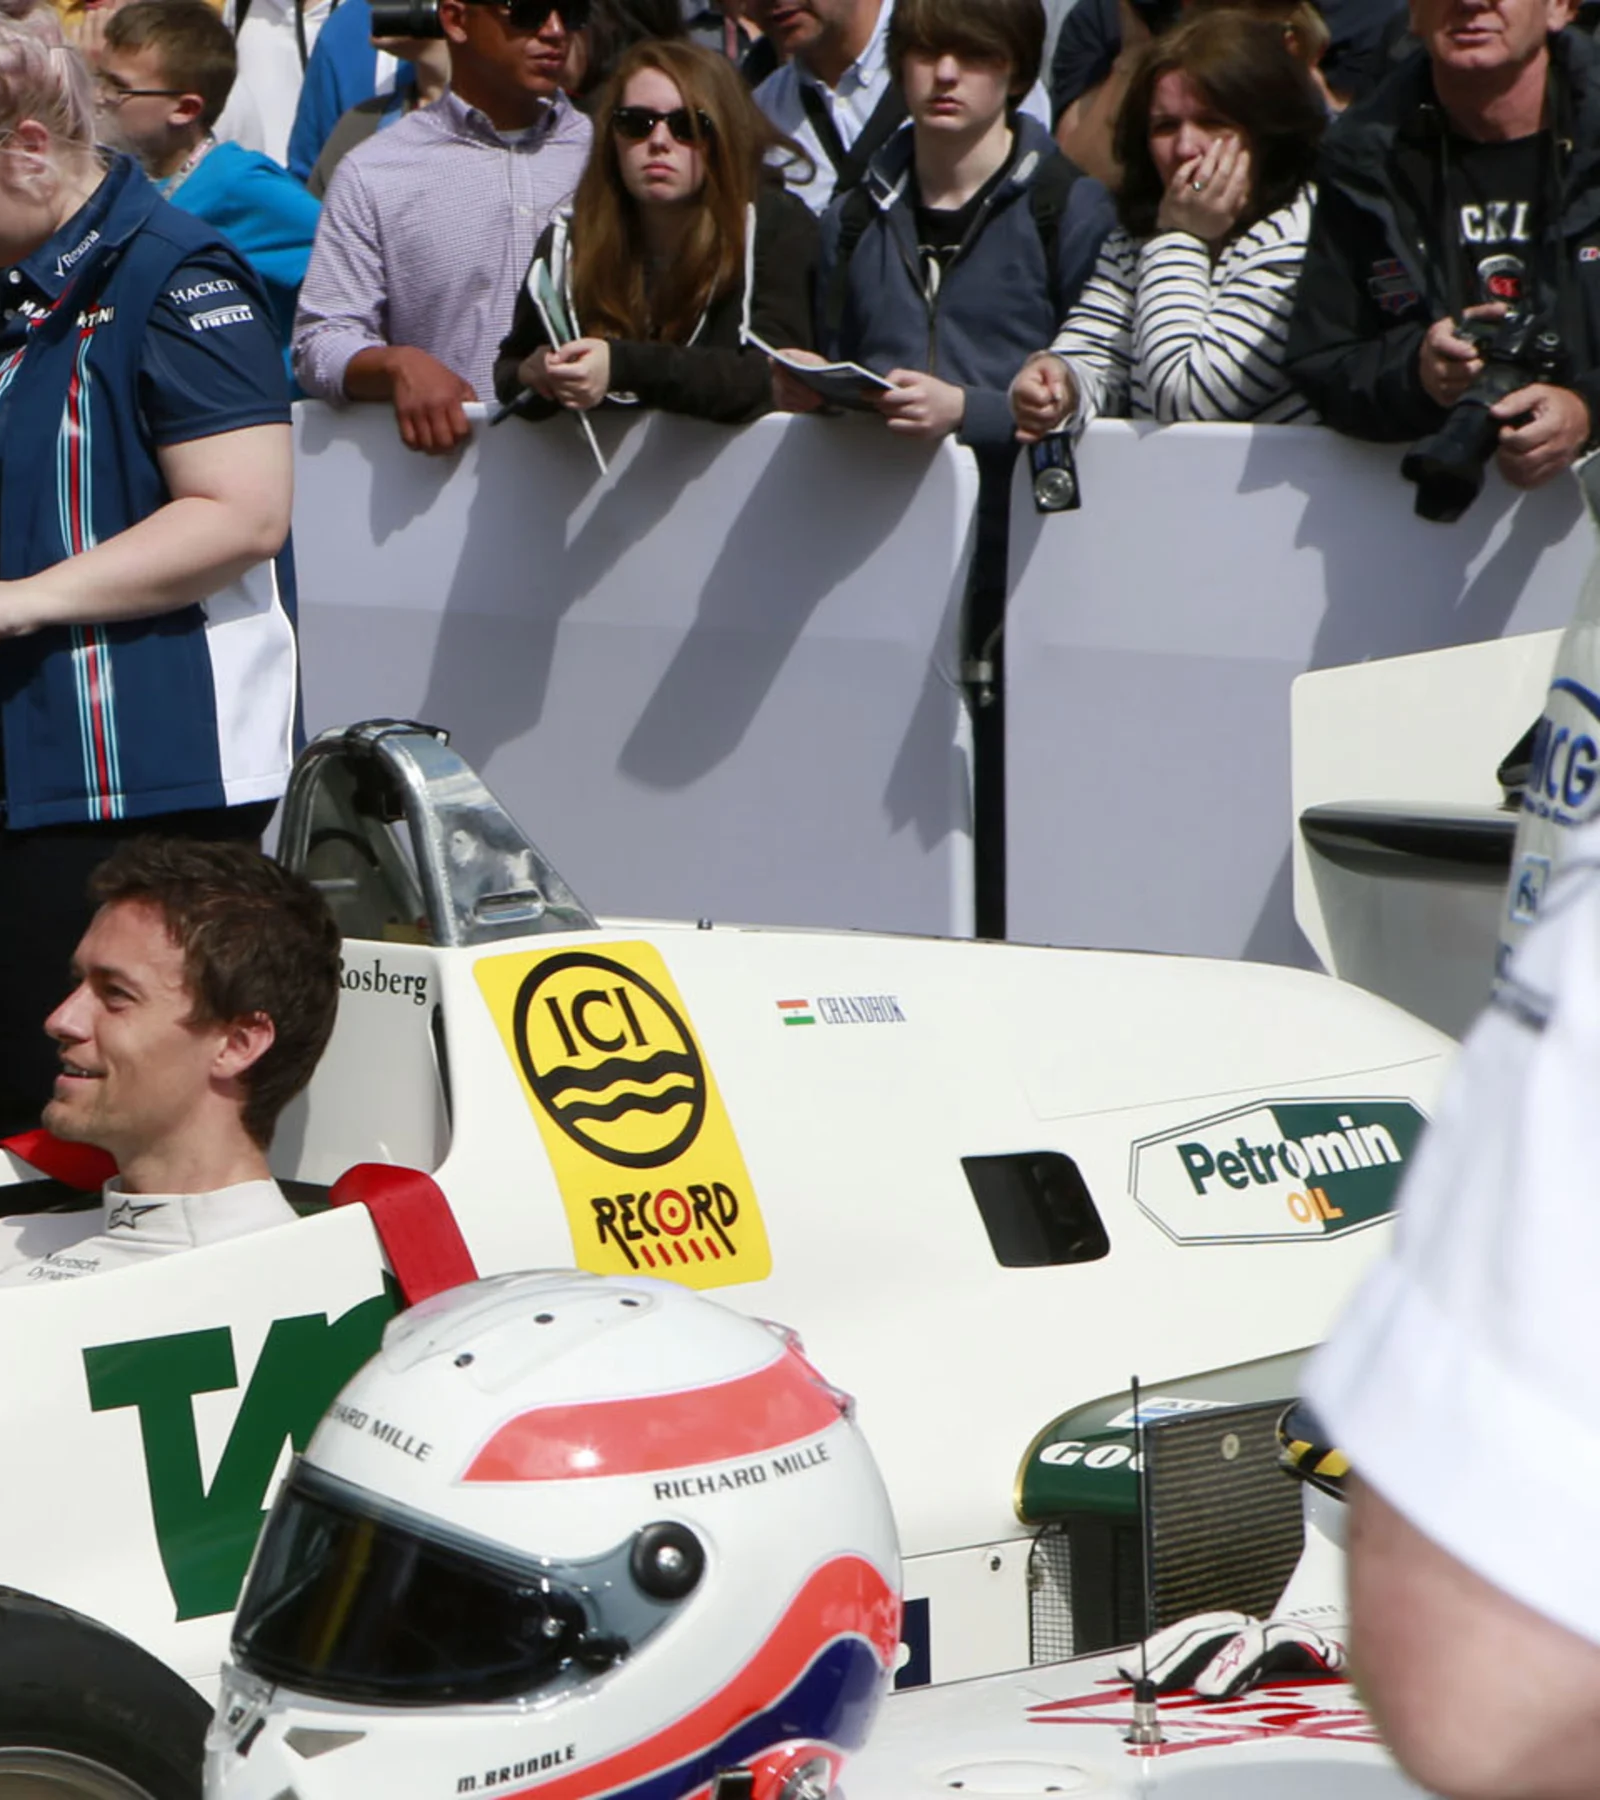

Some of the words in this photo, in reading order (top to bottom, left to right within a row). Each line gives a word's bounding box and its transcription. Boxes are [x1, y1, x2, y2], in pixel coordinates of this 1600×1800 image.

[62, 229, 100, 268] Rexona
[189, 304, 254, 331] PIRELLI
[545, 987, 649, 1057] ICI
[816, 995, 907, 1025] CHANDHOK
[1176, 1115, 1403, 1196] Petromin
[591, 1182, 739, 1269] RECORD
[1287, 1187, 1344, 1223] OIL
[370, 1419, 434, 1463] MILLE
[653, 1464, 767, 1501] RICHARD
[771, 1442, 832, 1478] MILLE
